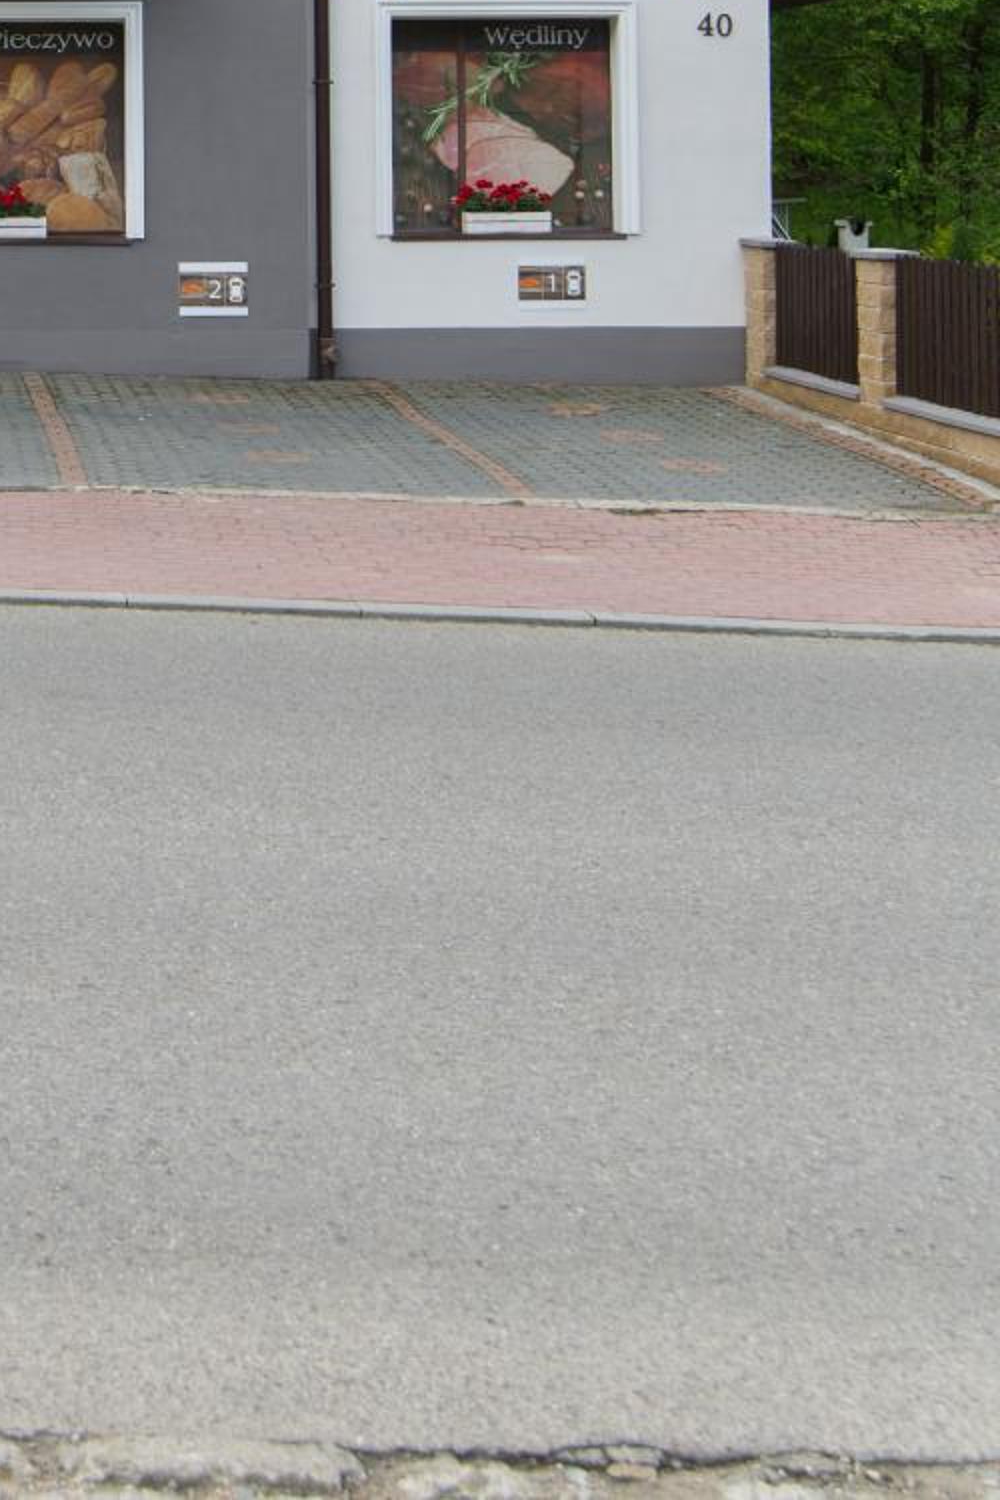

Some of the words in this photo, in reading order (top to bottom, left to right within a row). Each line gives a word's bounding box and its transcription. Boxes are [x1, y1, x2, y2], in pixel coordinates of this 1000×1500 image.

[483, 25, 589, 50] Wędliny
[696, 12, 733, 38] 40
[208, 279, 222, 299] 2
